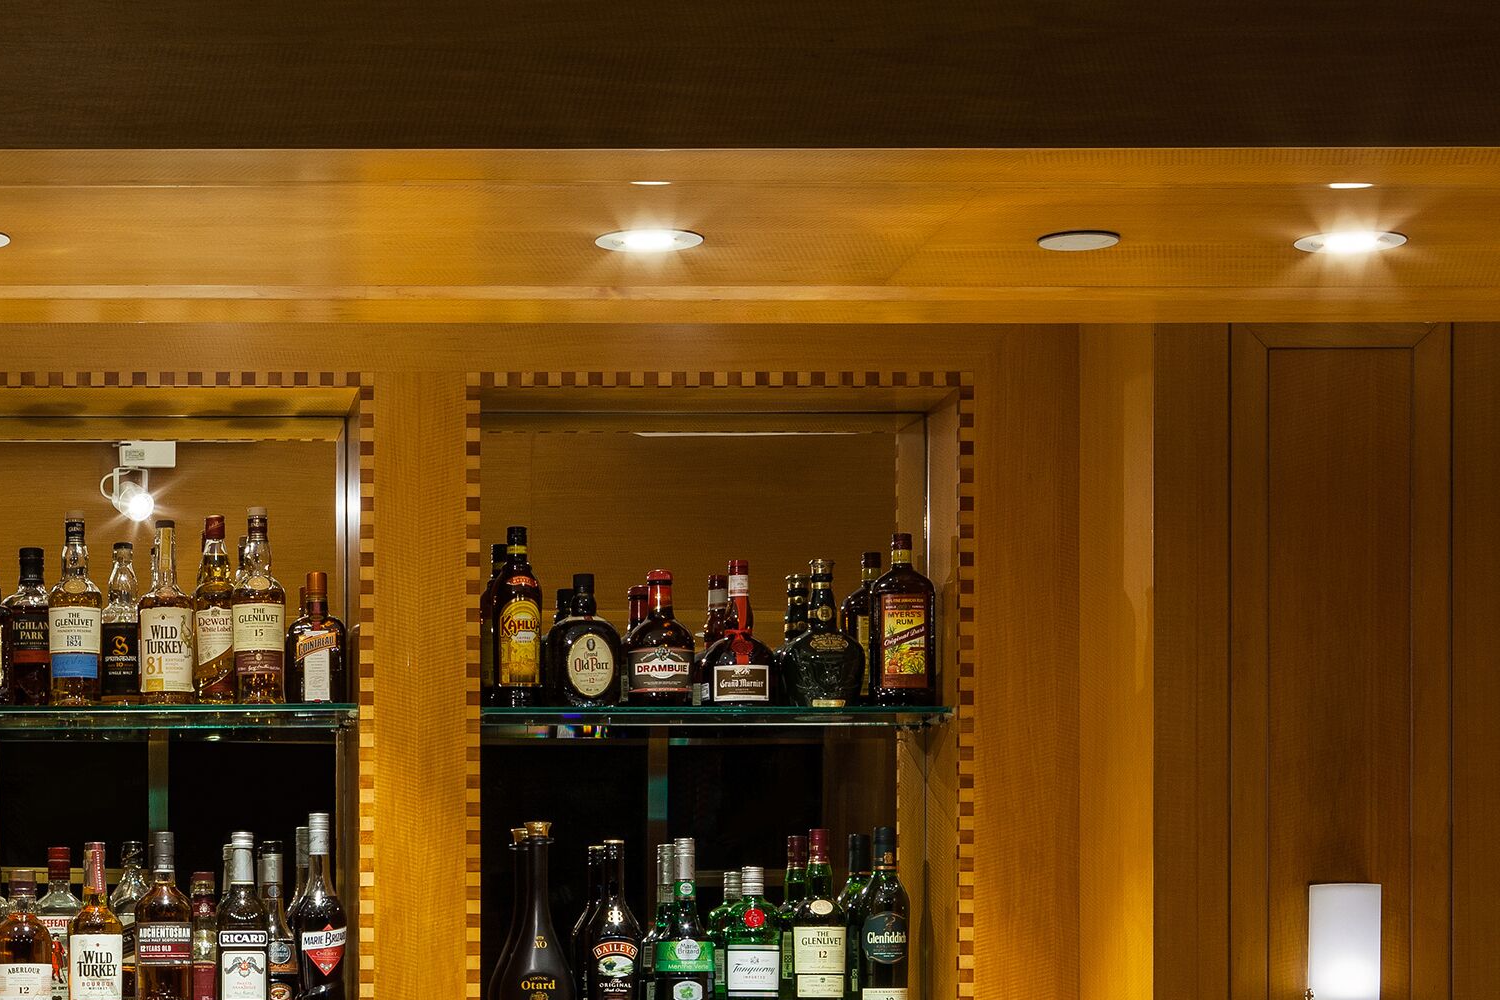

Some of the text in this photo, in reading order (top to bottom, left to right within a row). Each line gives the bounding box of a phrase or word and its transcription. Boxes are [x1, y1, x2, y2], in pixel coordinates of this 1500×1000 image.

[238, 614, 279, 624] GLENLIVET
[888, 611, 921, 619] MYERS'S
[55, 619, 94, 628] GLENLIVET
[896, 618, 914, 626] RUM
[20, 630, 44, 639] PARK
[150, 624, 178, 640] WILD
[254, 628, 263, 637] 15
[66, 639, 82, 647] 1824
[883, 632, 909, 647] Original
[145, 639, 183, 655] TURKEY
[298, 635, 334, 655] COINTREAU
[145, 655, 164, 675] 81
[574, 659, 609, 673] Old Parr
[637, 663, 688, 674] DRAMBUIE
[720, 679, 764, 689] Grand Marnier
[138, 926, 191, 938] AUCHENTOSHAN
[866, 930, 907, 944] Glenfiddich
[222, 934, 265, 943] RICARD
[303, 936, 324, 946] MARIE
[801, 936, 842, 946] GLENLIVET
[596, 944, 636, 957] BAILEYS
[818, 950, 827, 958] 12
[83, 950, 113, 964] WILD
[7, 965, 41, 976] ABERLOUR
[77, 962, 118, 978] TURKEY
[732, 963, 776, 976] Tanqueray
[18, 986, 30, 994] 12
[521, 980, 556, 990] Otard
